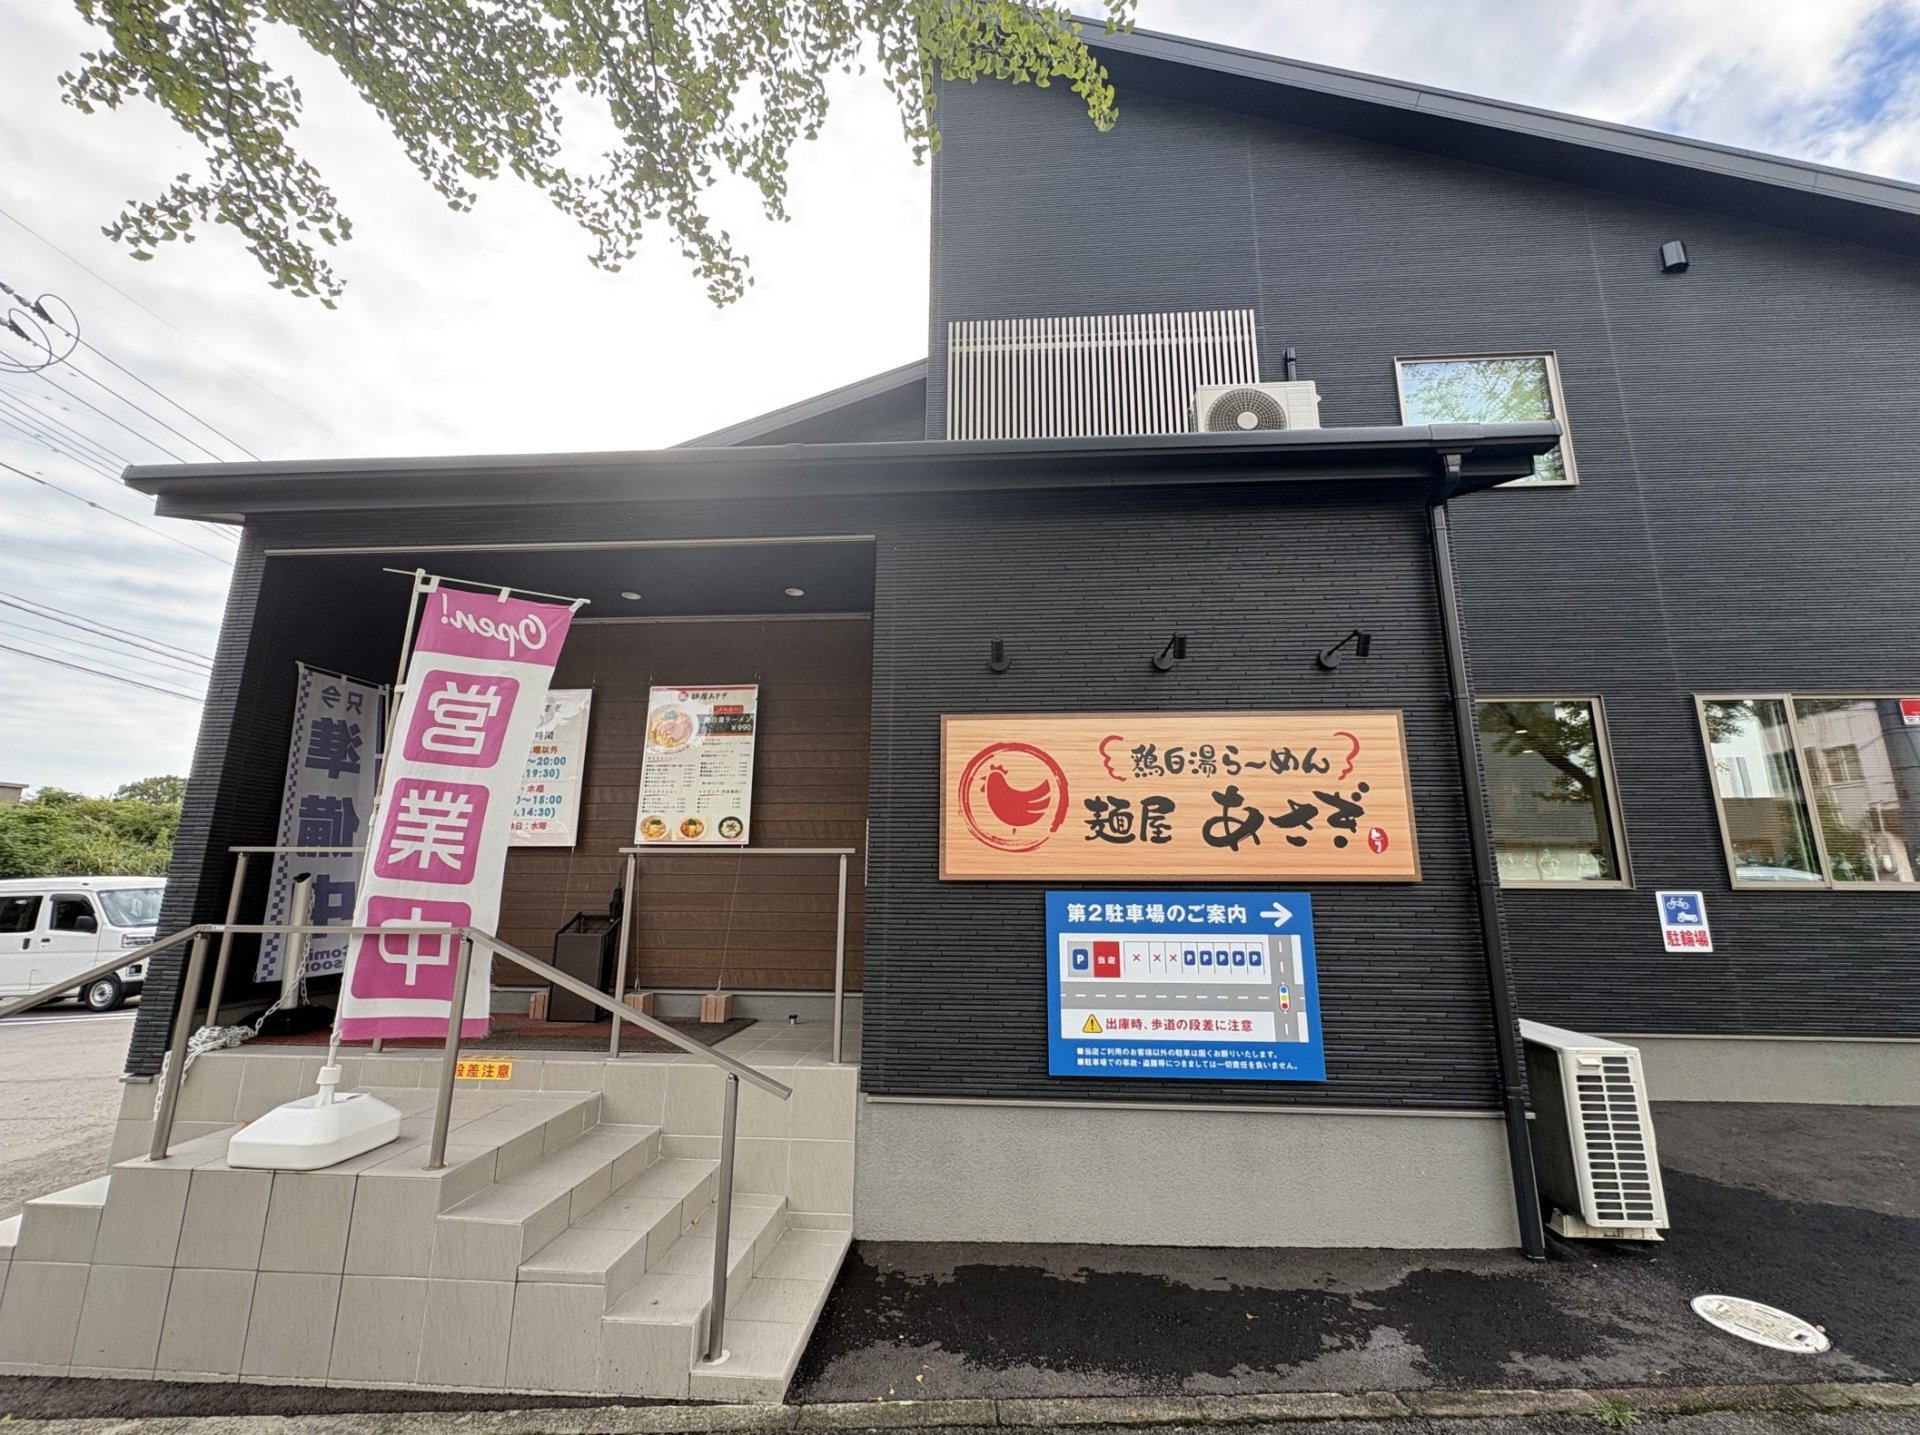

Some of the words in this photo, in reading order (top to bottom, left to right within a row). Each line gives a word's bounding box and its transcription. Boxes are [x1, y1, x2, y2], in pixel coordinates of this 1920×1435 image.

[529, 745, 558, 754] 曜以外
[513, 807, 556, 819] .14:30)
[1083, 795, 1177, 845] 麺屋
[1202, 781, 1370, 852] あさぎ
[1066, 903, 1248, 925] 第2駐車場のご案内
[1665, 930, 1710, 947] 駐輪場
[1097, 955, 1116, 965] 当店
[1105, 1016, 1254, 1032] 出庫時、歩道の段差に注意
